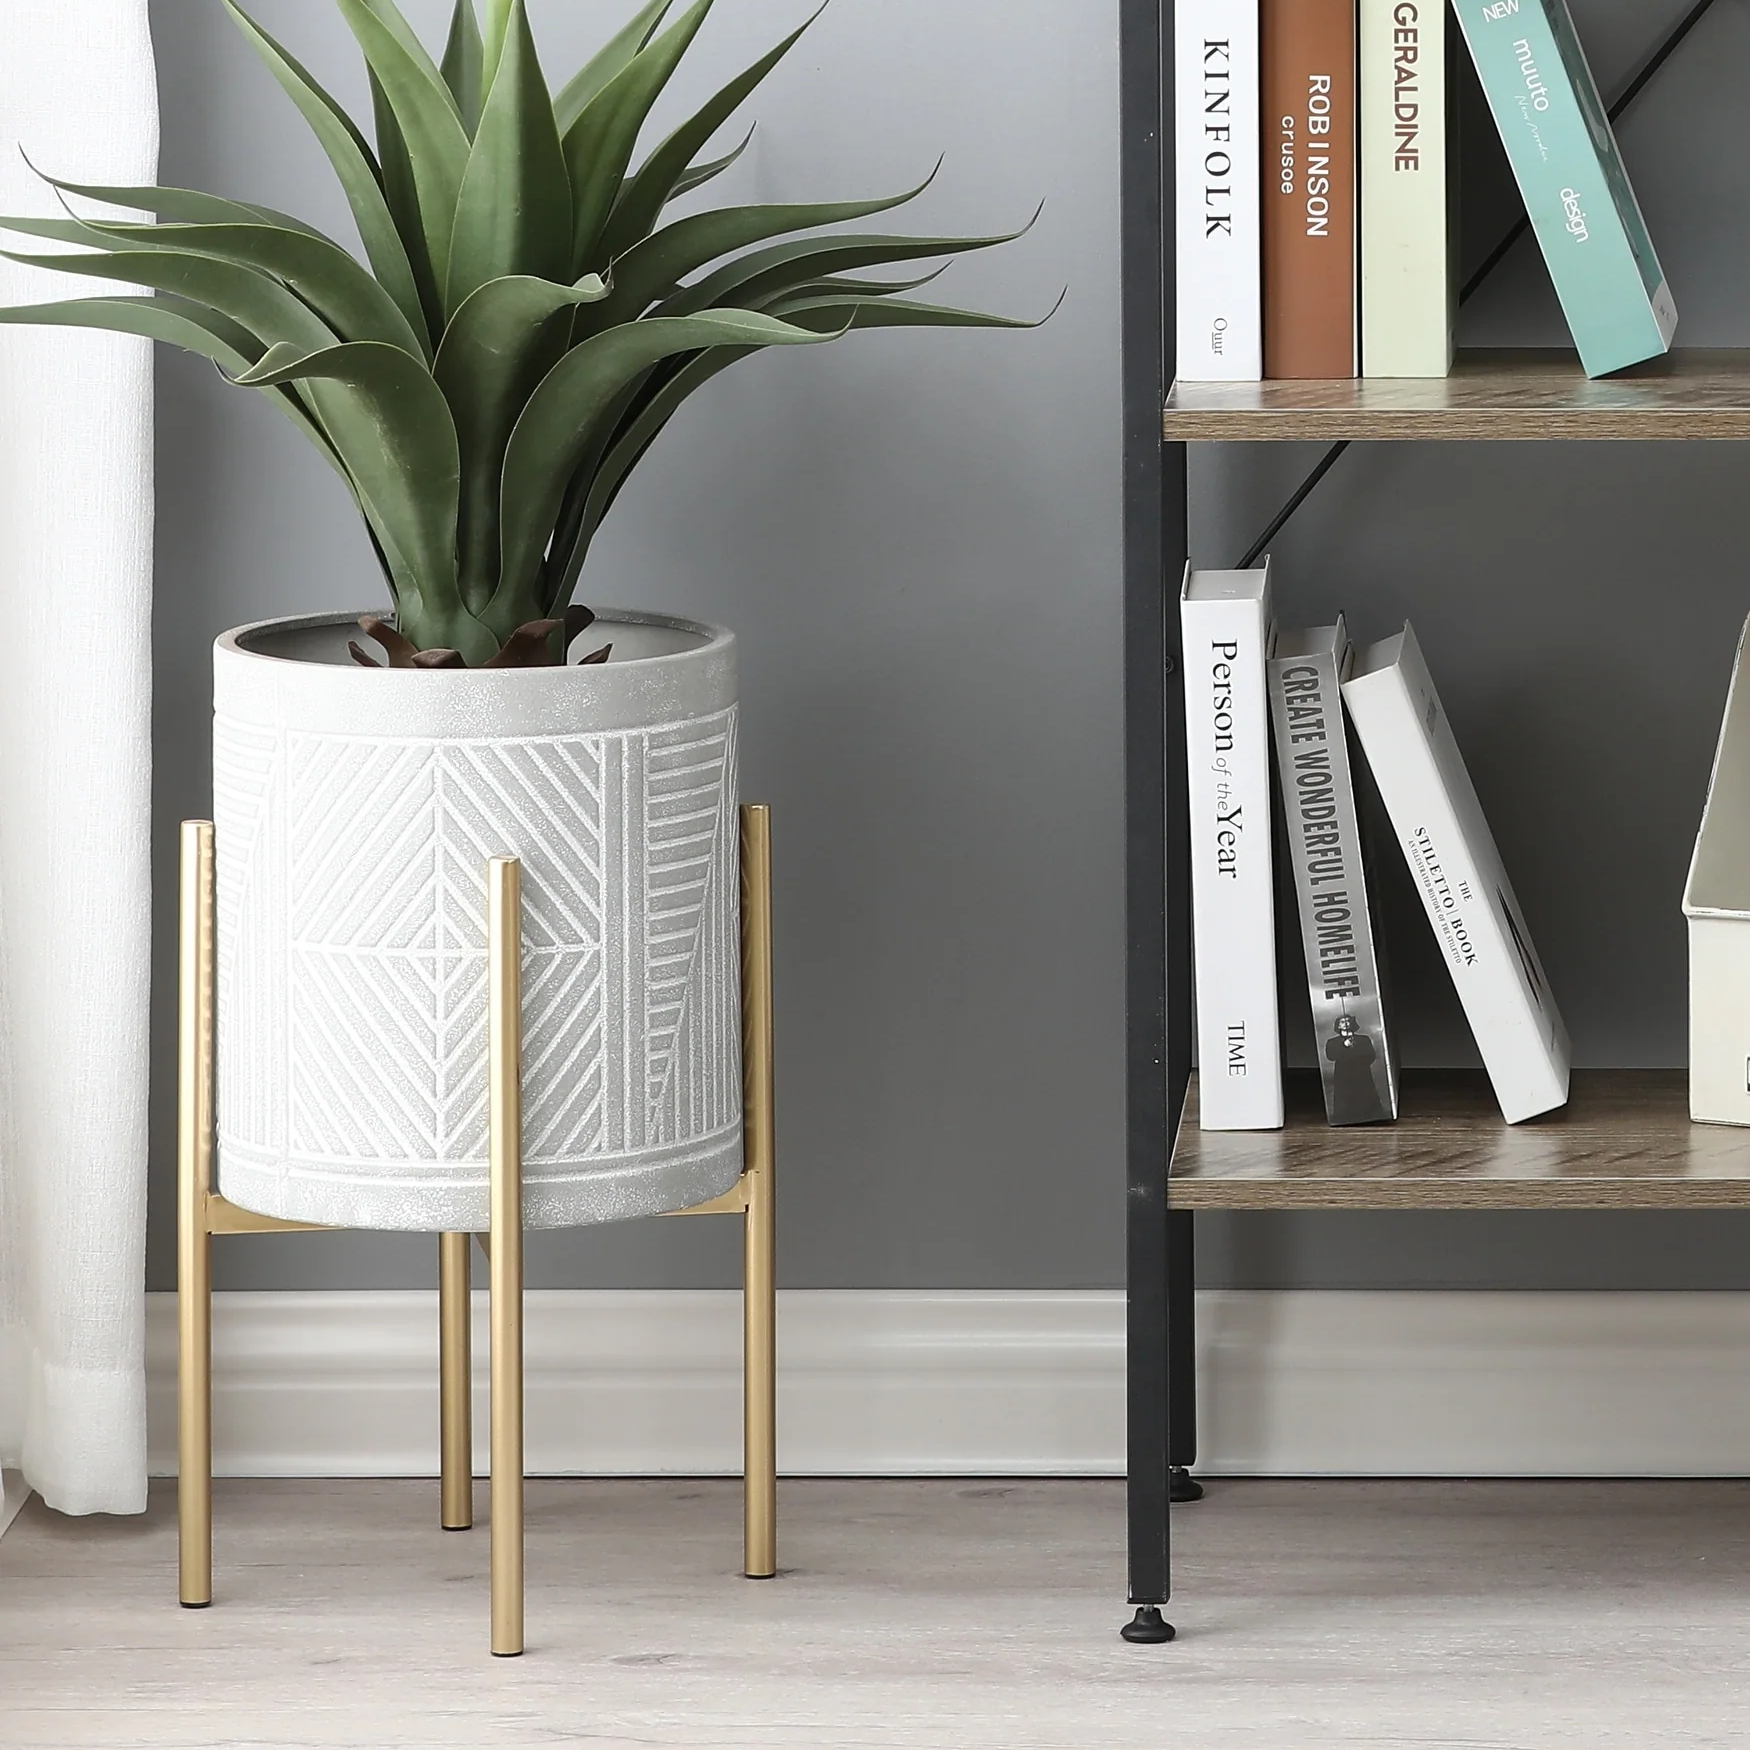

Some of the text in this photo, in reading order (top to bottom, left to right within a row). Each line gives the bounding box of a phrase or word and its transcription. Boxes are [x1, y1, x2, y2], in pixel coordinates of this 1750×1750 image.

[1393, 2, 1419, 172] GERALDINE
[1512, 38, 1549, 112] muuto
[1204, 38, 1232, 239] KINFOLK
[1280, 115, 1295, 195] crusoe
[1560, 187, 1589, 243] design
[1212, 317, 1228, 356] Ouur
[1211, 638, 1243, 879] Person of the Year
[1281, 665, 1361, 1001] CREATE WONDERFUL HOMELIFE
[1414, 826, 1478, 967] STILETTO BOOK
[1458, 880, 1473, 903] THE
[1227, 1019, 1247, 1077] TIME
